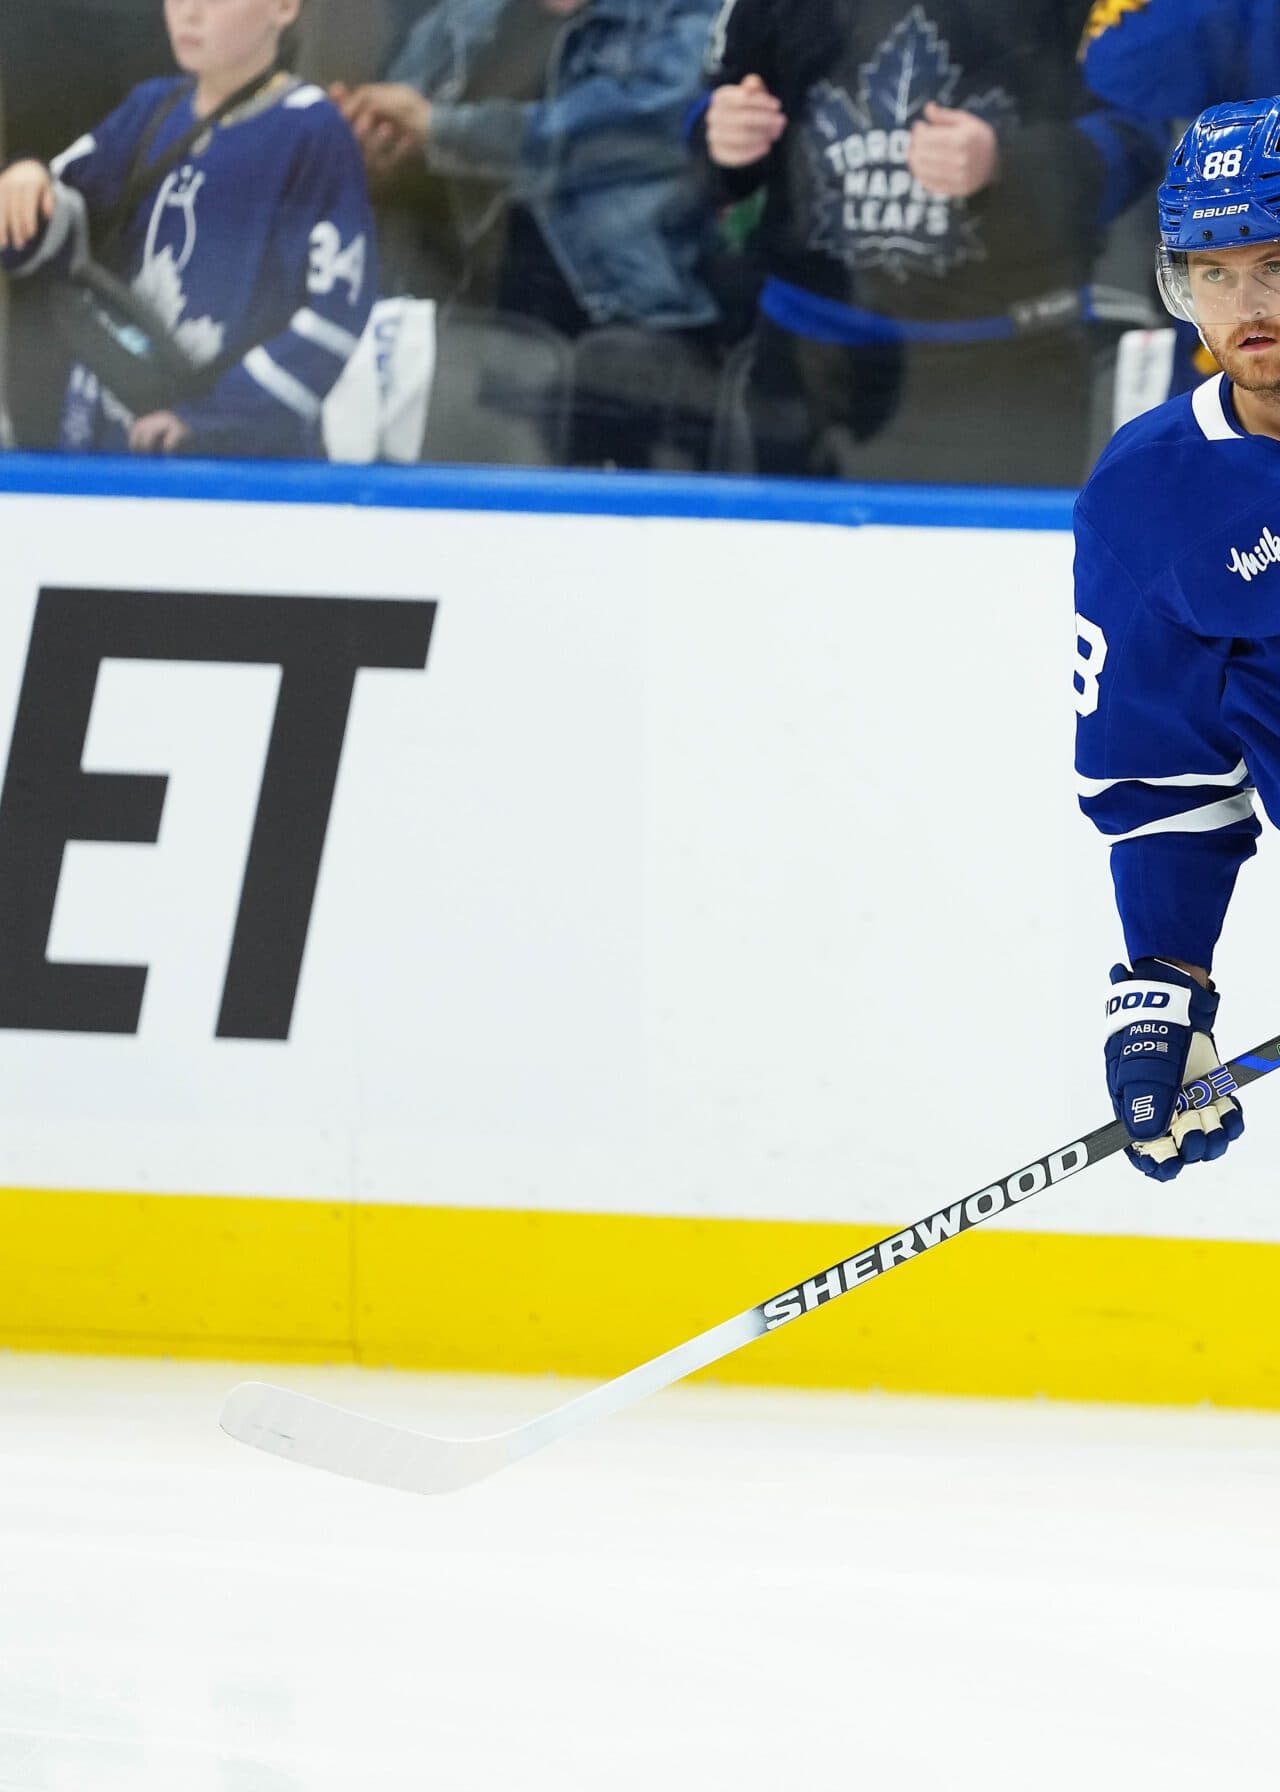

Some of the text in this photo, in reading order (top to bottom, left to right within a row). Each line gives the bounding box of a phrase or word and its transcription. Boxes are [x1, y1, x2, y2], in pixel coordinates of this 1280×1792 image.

[825, 129, 913, 175] TORO
[1203, 150, 1242, 180] 88
[843, 200, 949, 235] LEAFS
[1192, 203, 1250, 220] BAUER
[307, 221, 366, 306] 34
[0, 586, 439, 1041] ET
[1105, 991, 1170, 1018] OOD
[1129, 1023, 1169, 1036] PABLO
[762, 1140, 1089, 1331] SHERWOOD
